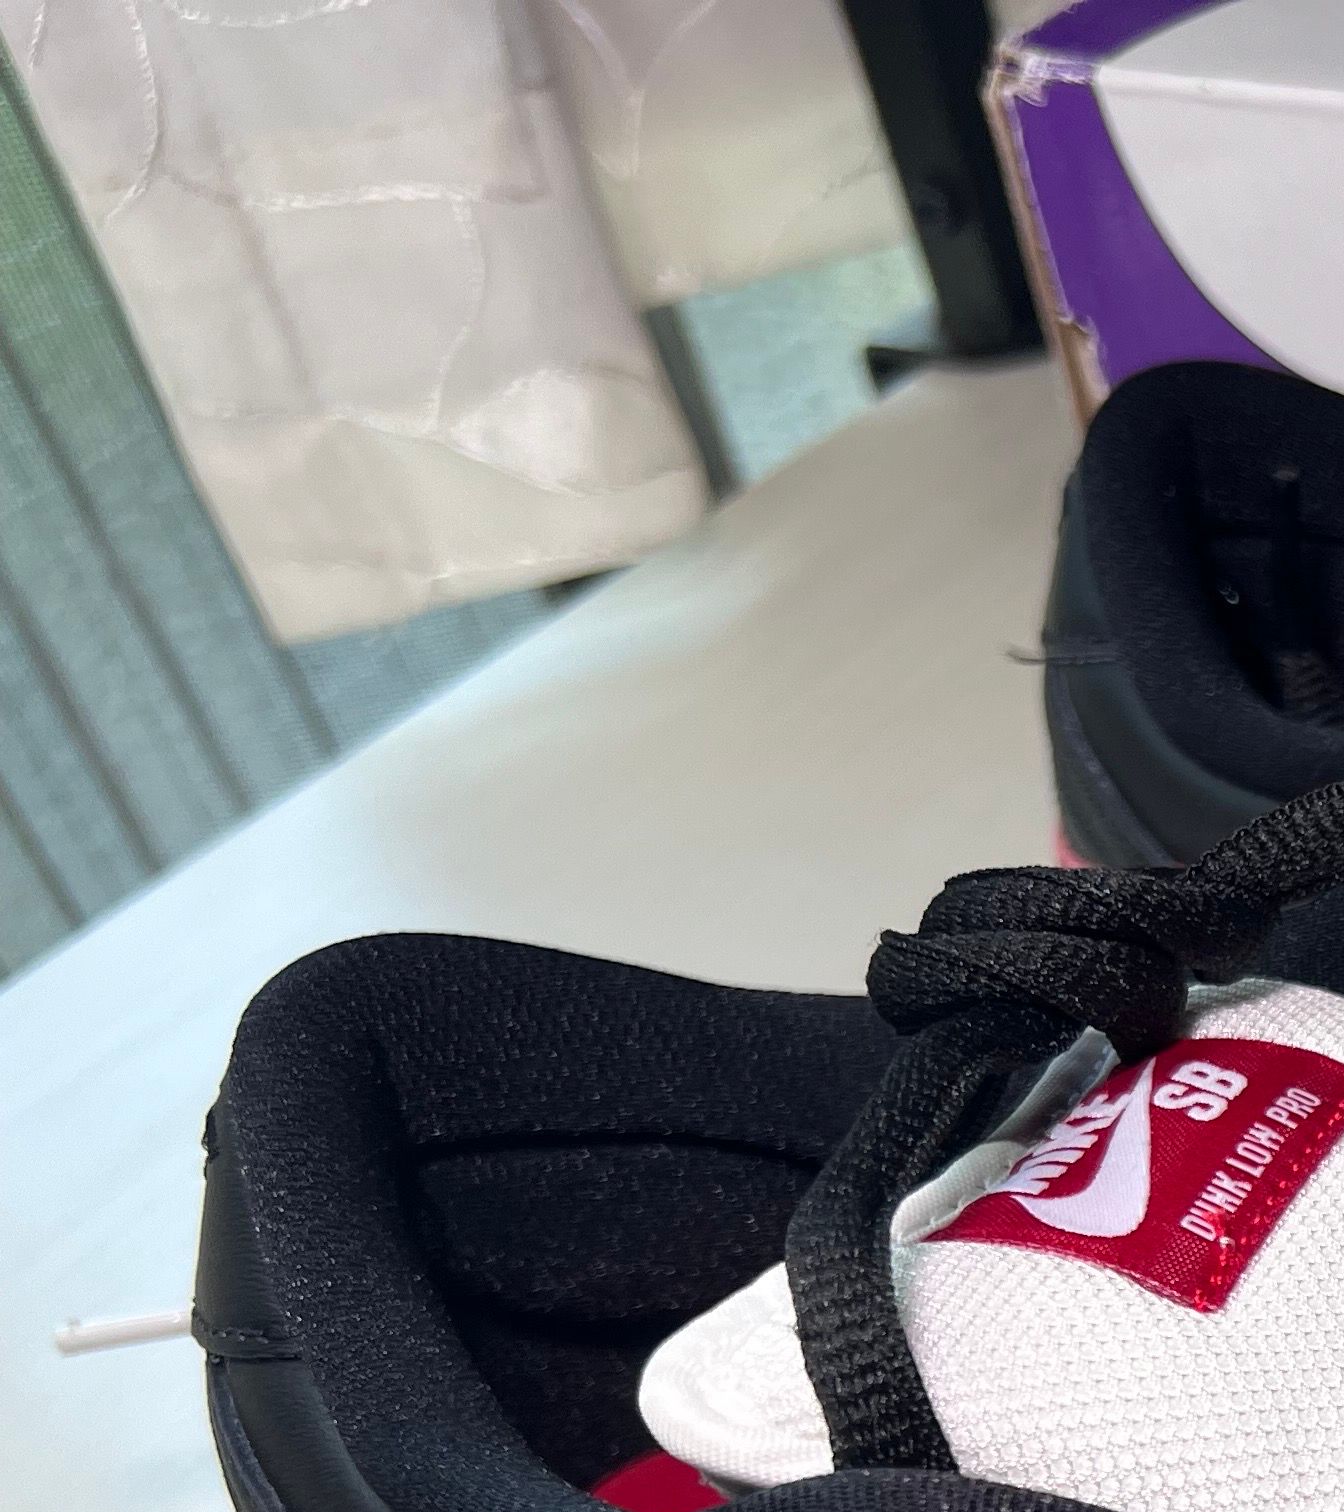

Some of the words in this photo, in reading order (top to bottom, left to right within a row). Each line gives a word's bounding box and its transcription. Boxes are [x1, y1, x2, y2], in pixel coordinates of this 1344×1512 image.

[1153, 1060, 1249, 1121] SB
[1179, 1170, 1252, 1242] DUNK
[1224, 1121, 1286, 1178] LOW
[1264, 1087, 1322, 1130] PRO
